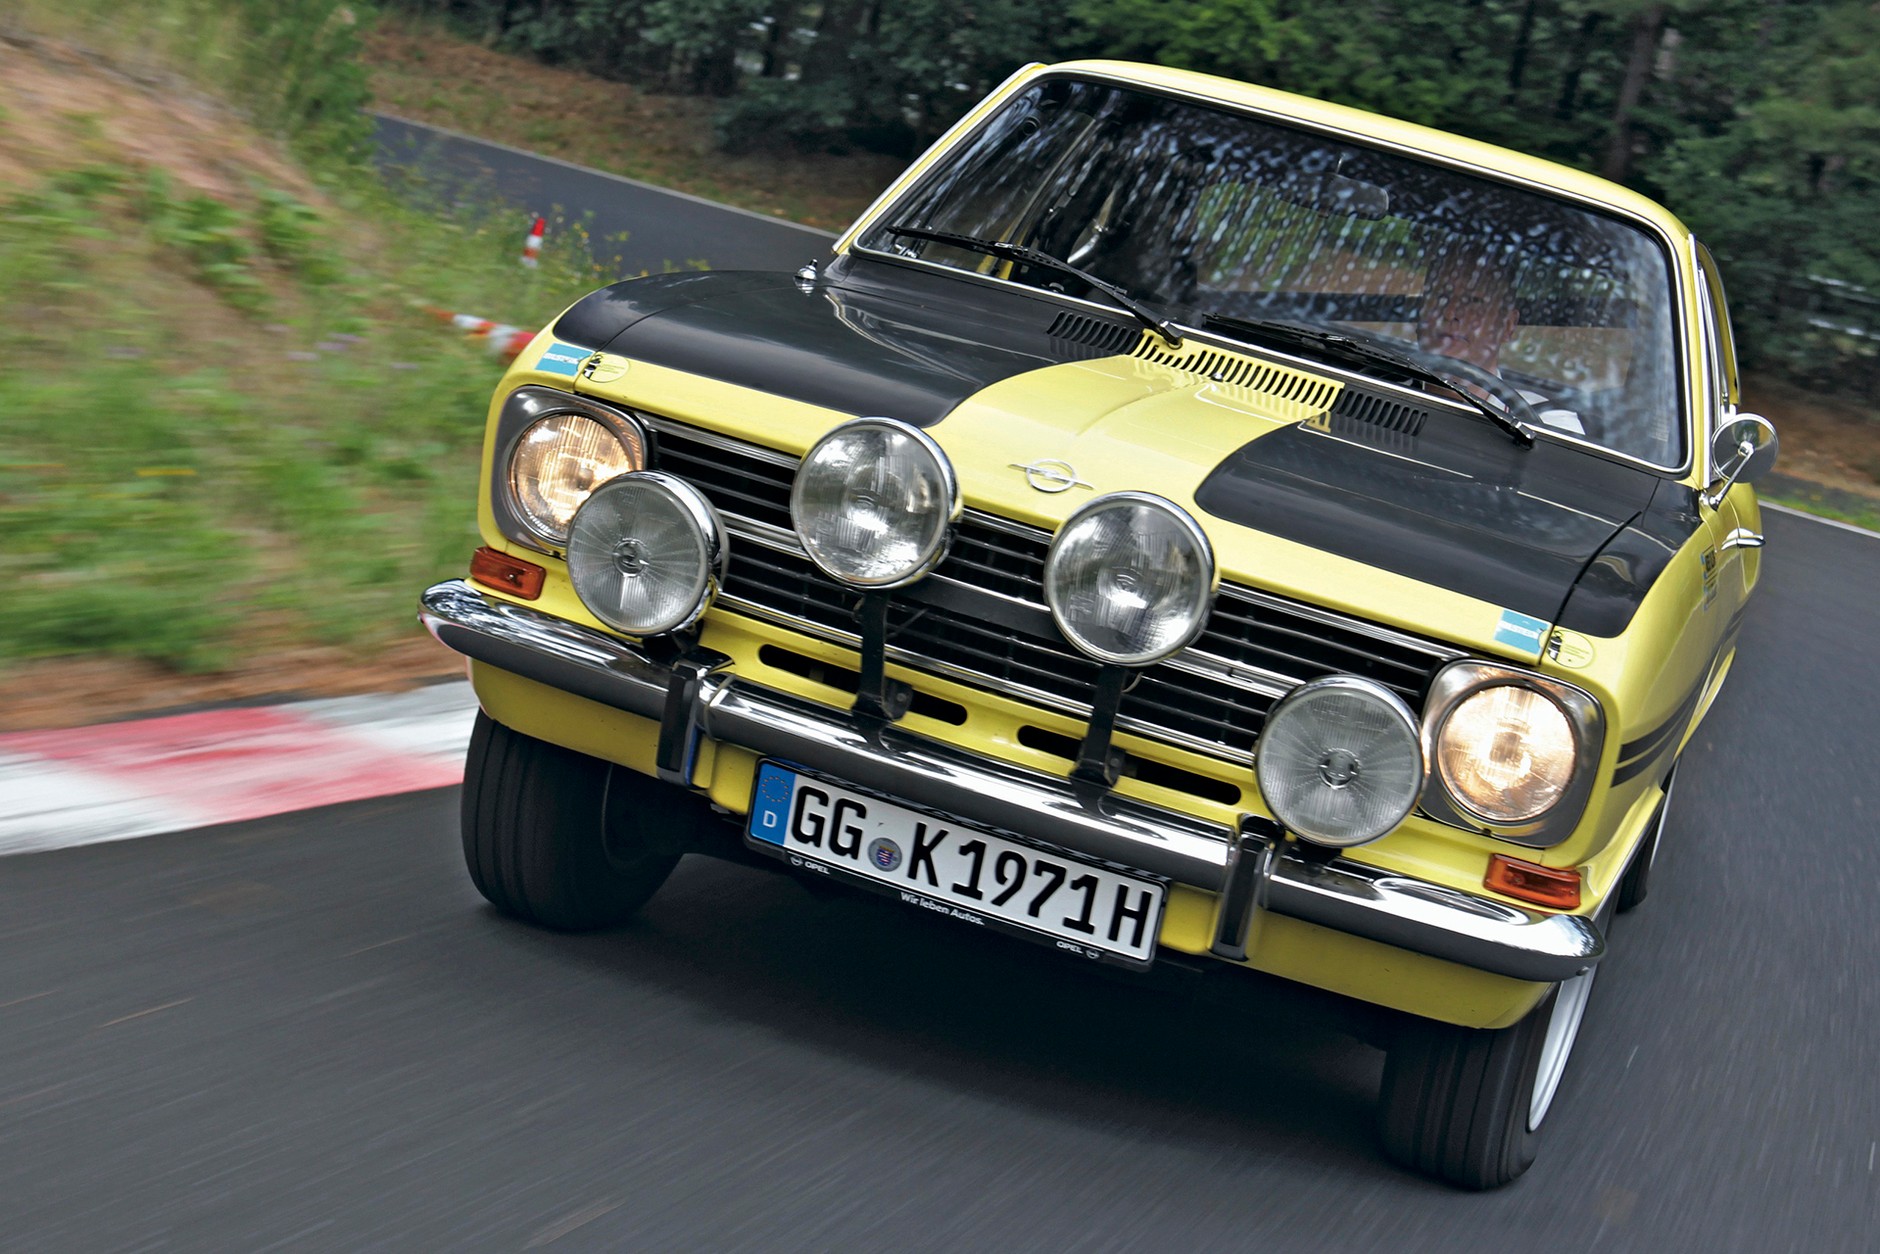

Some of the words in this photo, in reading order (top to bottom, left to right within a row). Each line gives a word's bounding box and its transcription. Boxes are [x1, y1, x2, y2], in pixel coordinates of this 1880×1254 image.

[762, 810, 778, 828] D
[791, 785, 867, 860] GG
[804, 861, 831, 875] OPEL
[901, 892, 918, 904] Wir
[919, 897, 949, 915] leben
[950, 907, 986, 926] Autos.
[1056, 940, 1084, 954] OPEL
